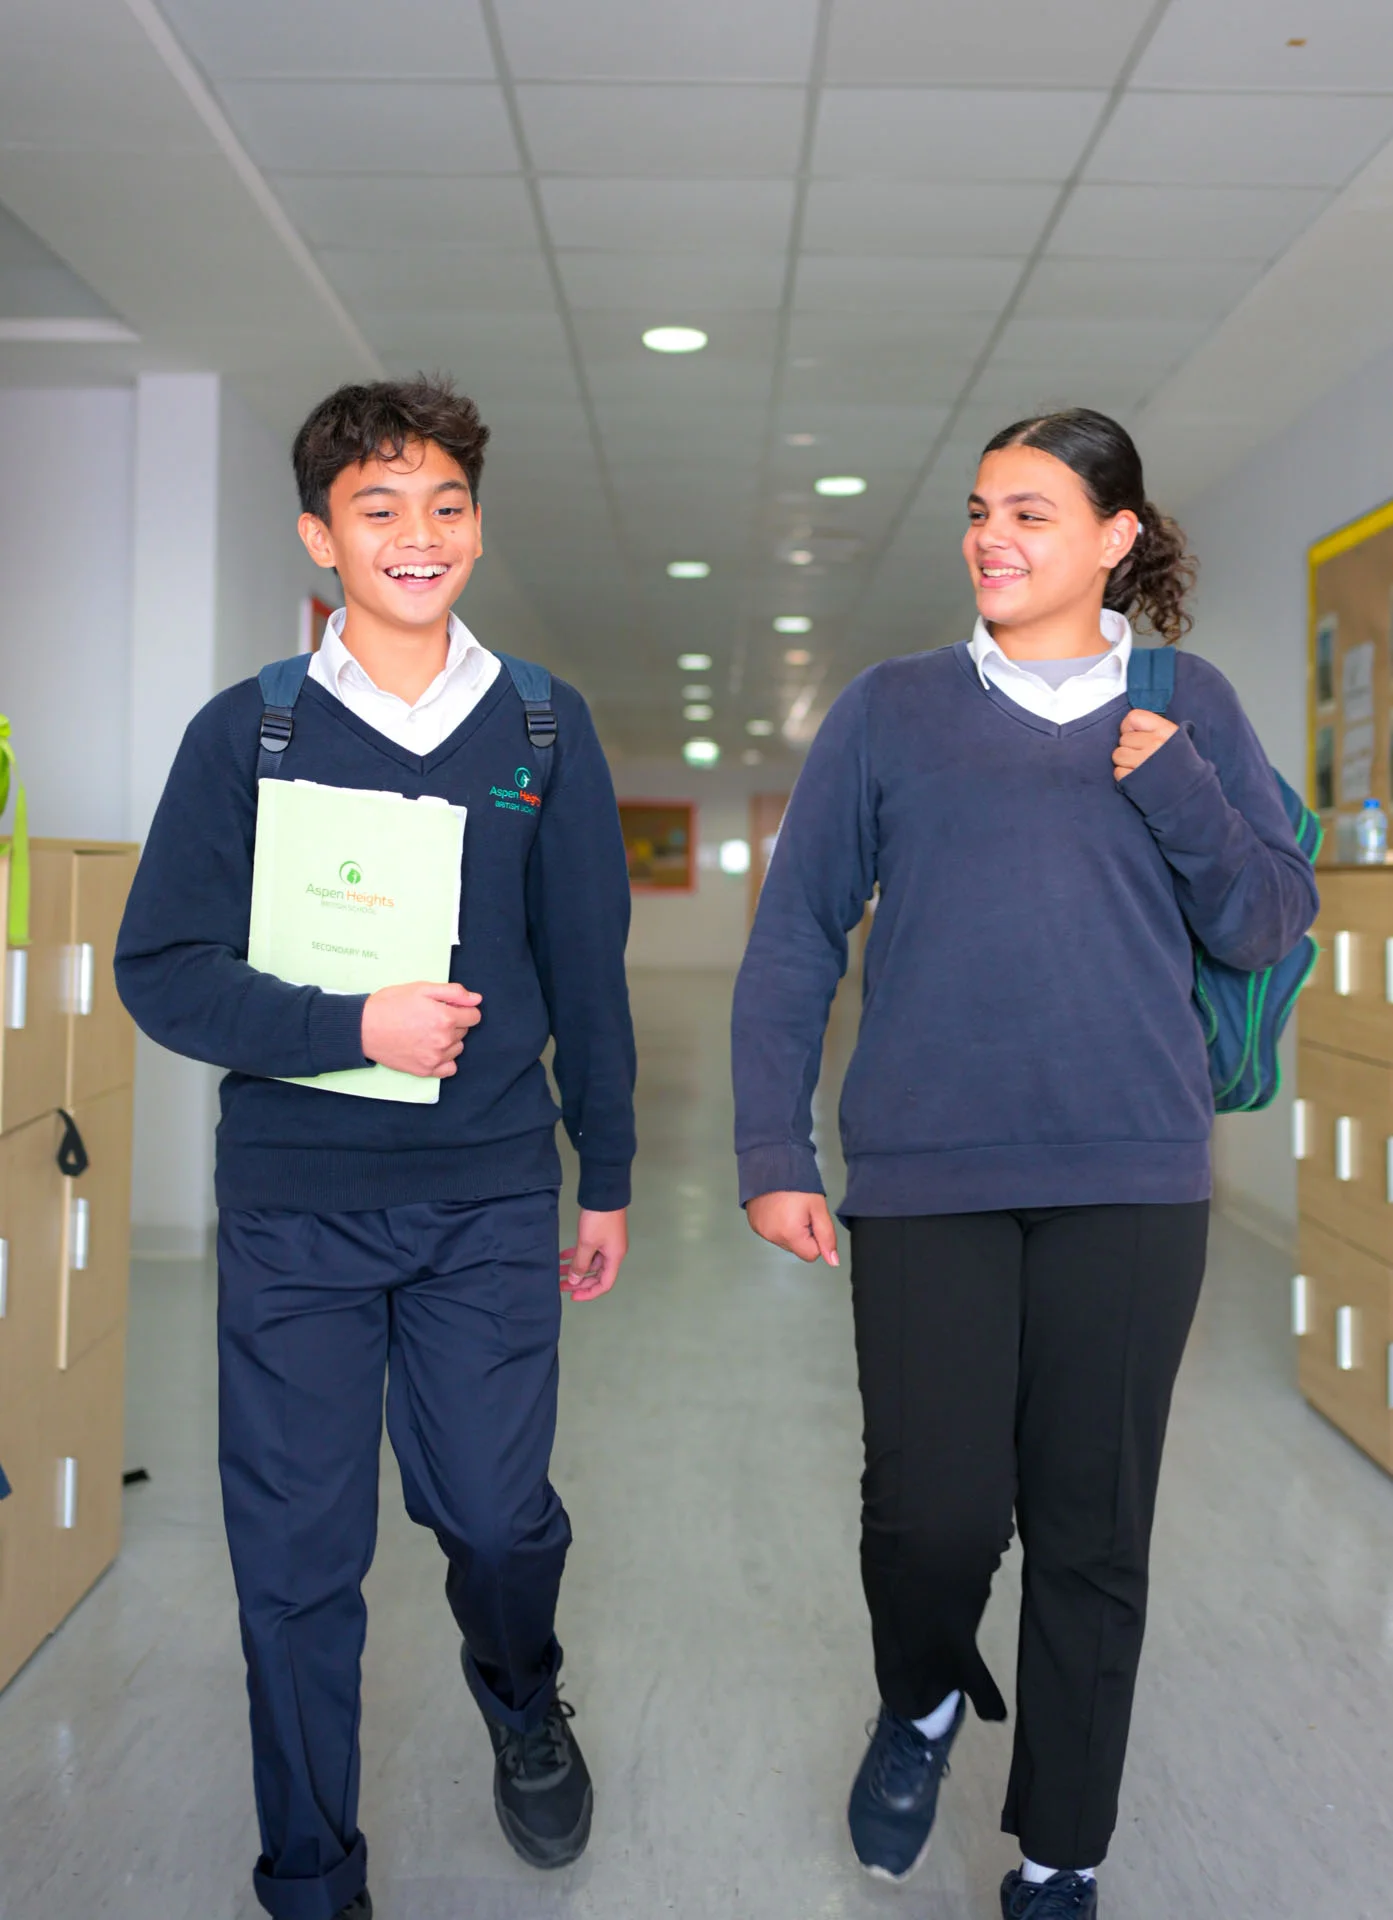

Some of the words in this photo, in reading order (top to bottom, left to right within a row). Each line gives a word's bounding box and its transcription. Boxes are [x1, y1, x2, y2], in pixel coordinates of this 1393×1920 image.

[489, 786, 519, 799] Aspen
[495, 800, 520, 810] BRITISH
[305, 883, 344, 900] Aspen
[346, 889, 395, 907] Heights
[347, 904, 377, 915] SCHOOL
[311, 941, 360, 955] SECONDARY
[361, 949, 380, 960] MFL
